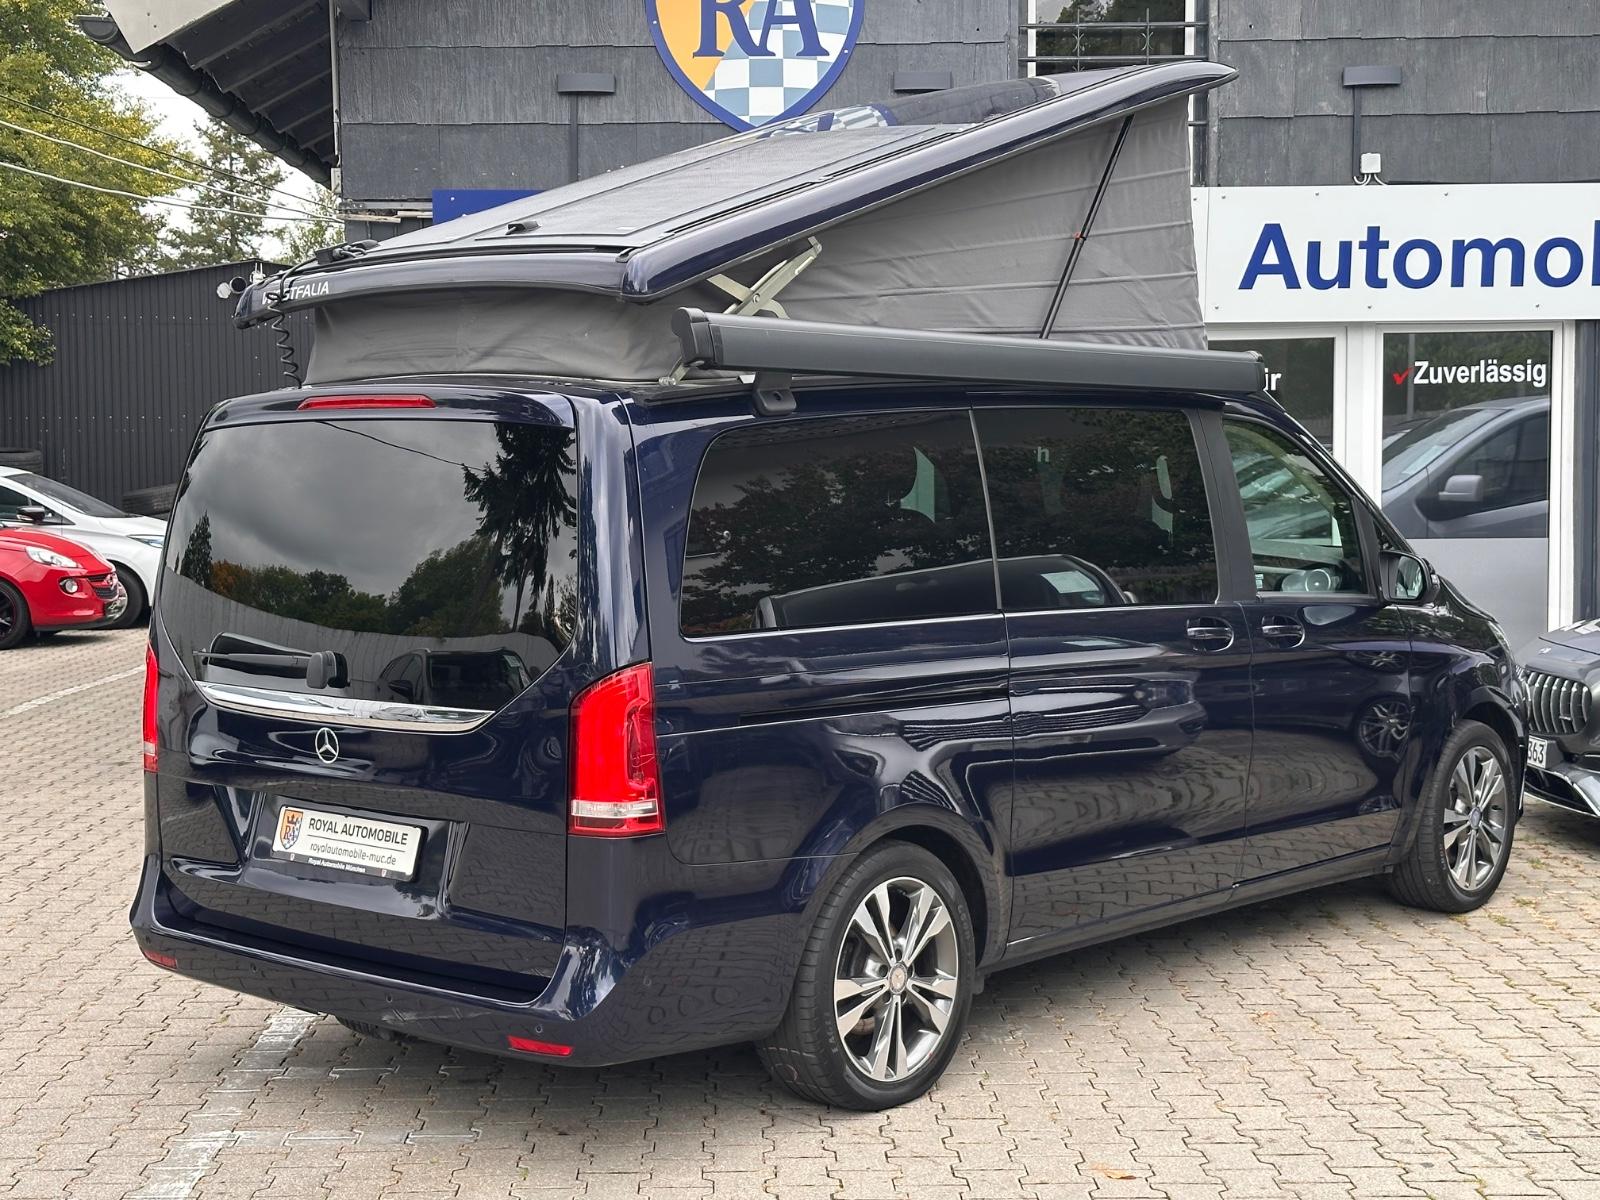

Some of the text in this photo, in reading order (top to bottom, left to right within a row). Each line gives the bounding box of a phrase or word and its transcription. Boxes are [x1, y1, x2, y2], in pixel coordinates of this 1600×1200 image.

[1413, 359, 1547, 388] Zuverlässig
[308, 817, 409, 846] ROYAL AUTOMOBILE
[310, 843, 397, 866] royalautomobile-muc.de
